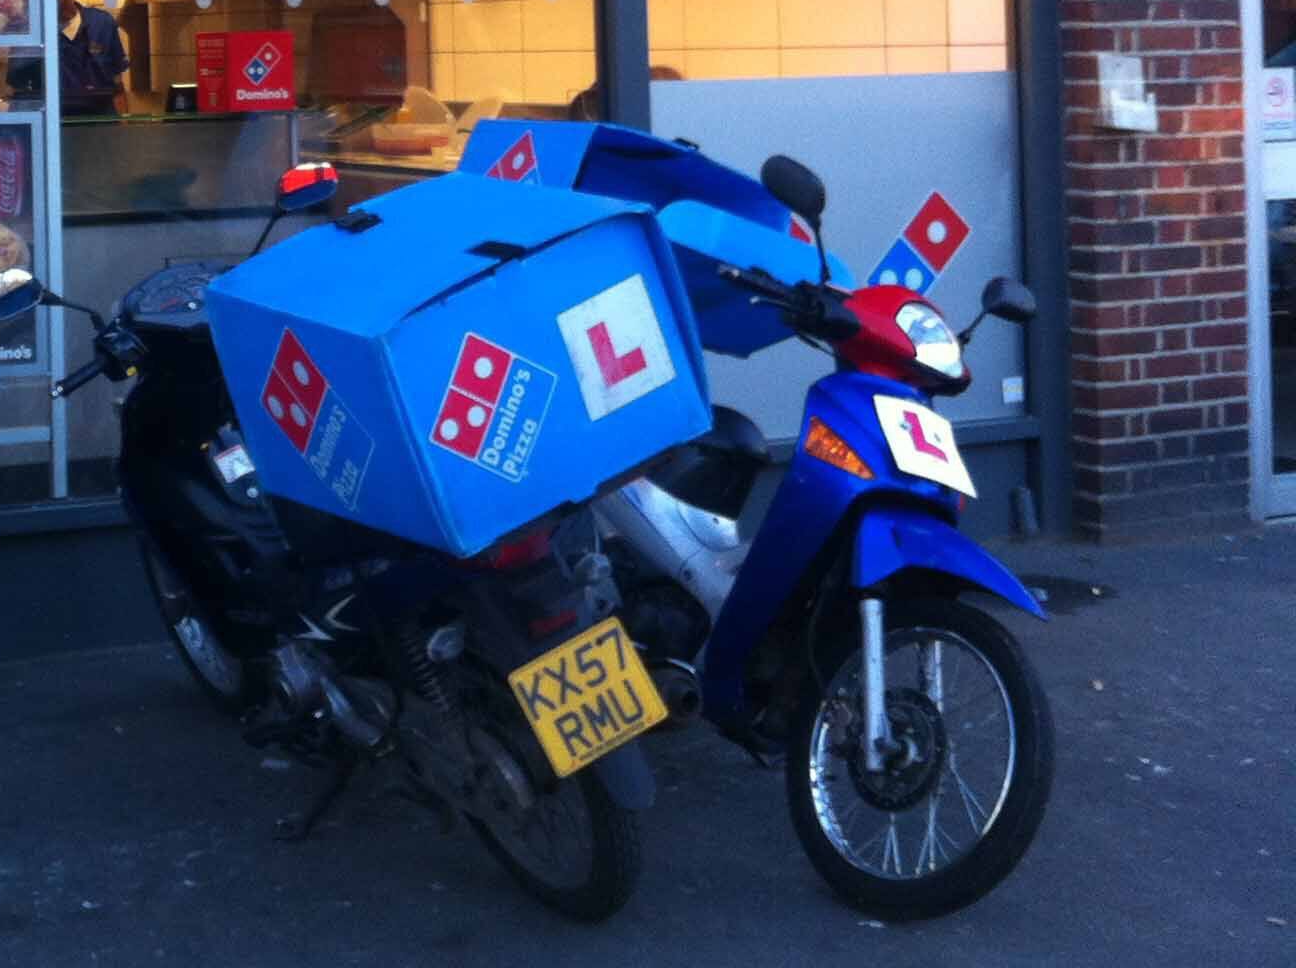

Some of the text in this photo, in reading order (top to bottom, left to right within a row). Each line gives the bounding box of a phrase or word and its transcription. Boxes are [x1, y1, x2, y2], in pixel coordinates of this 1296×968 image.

[236, 87, 289, 101] Domino's
[586, 321, 647, 389] L
[482, 369, 531, 466] Domino's
[503, 419, 537, 475] Pizza
[902, 410, 949, 464] L
[517, 627, 626, 720] KX57
[554, 679, 644, 756] RMU
